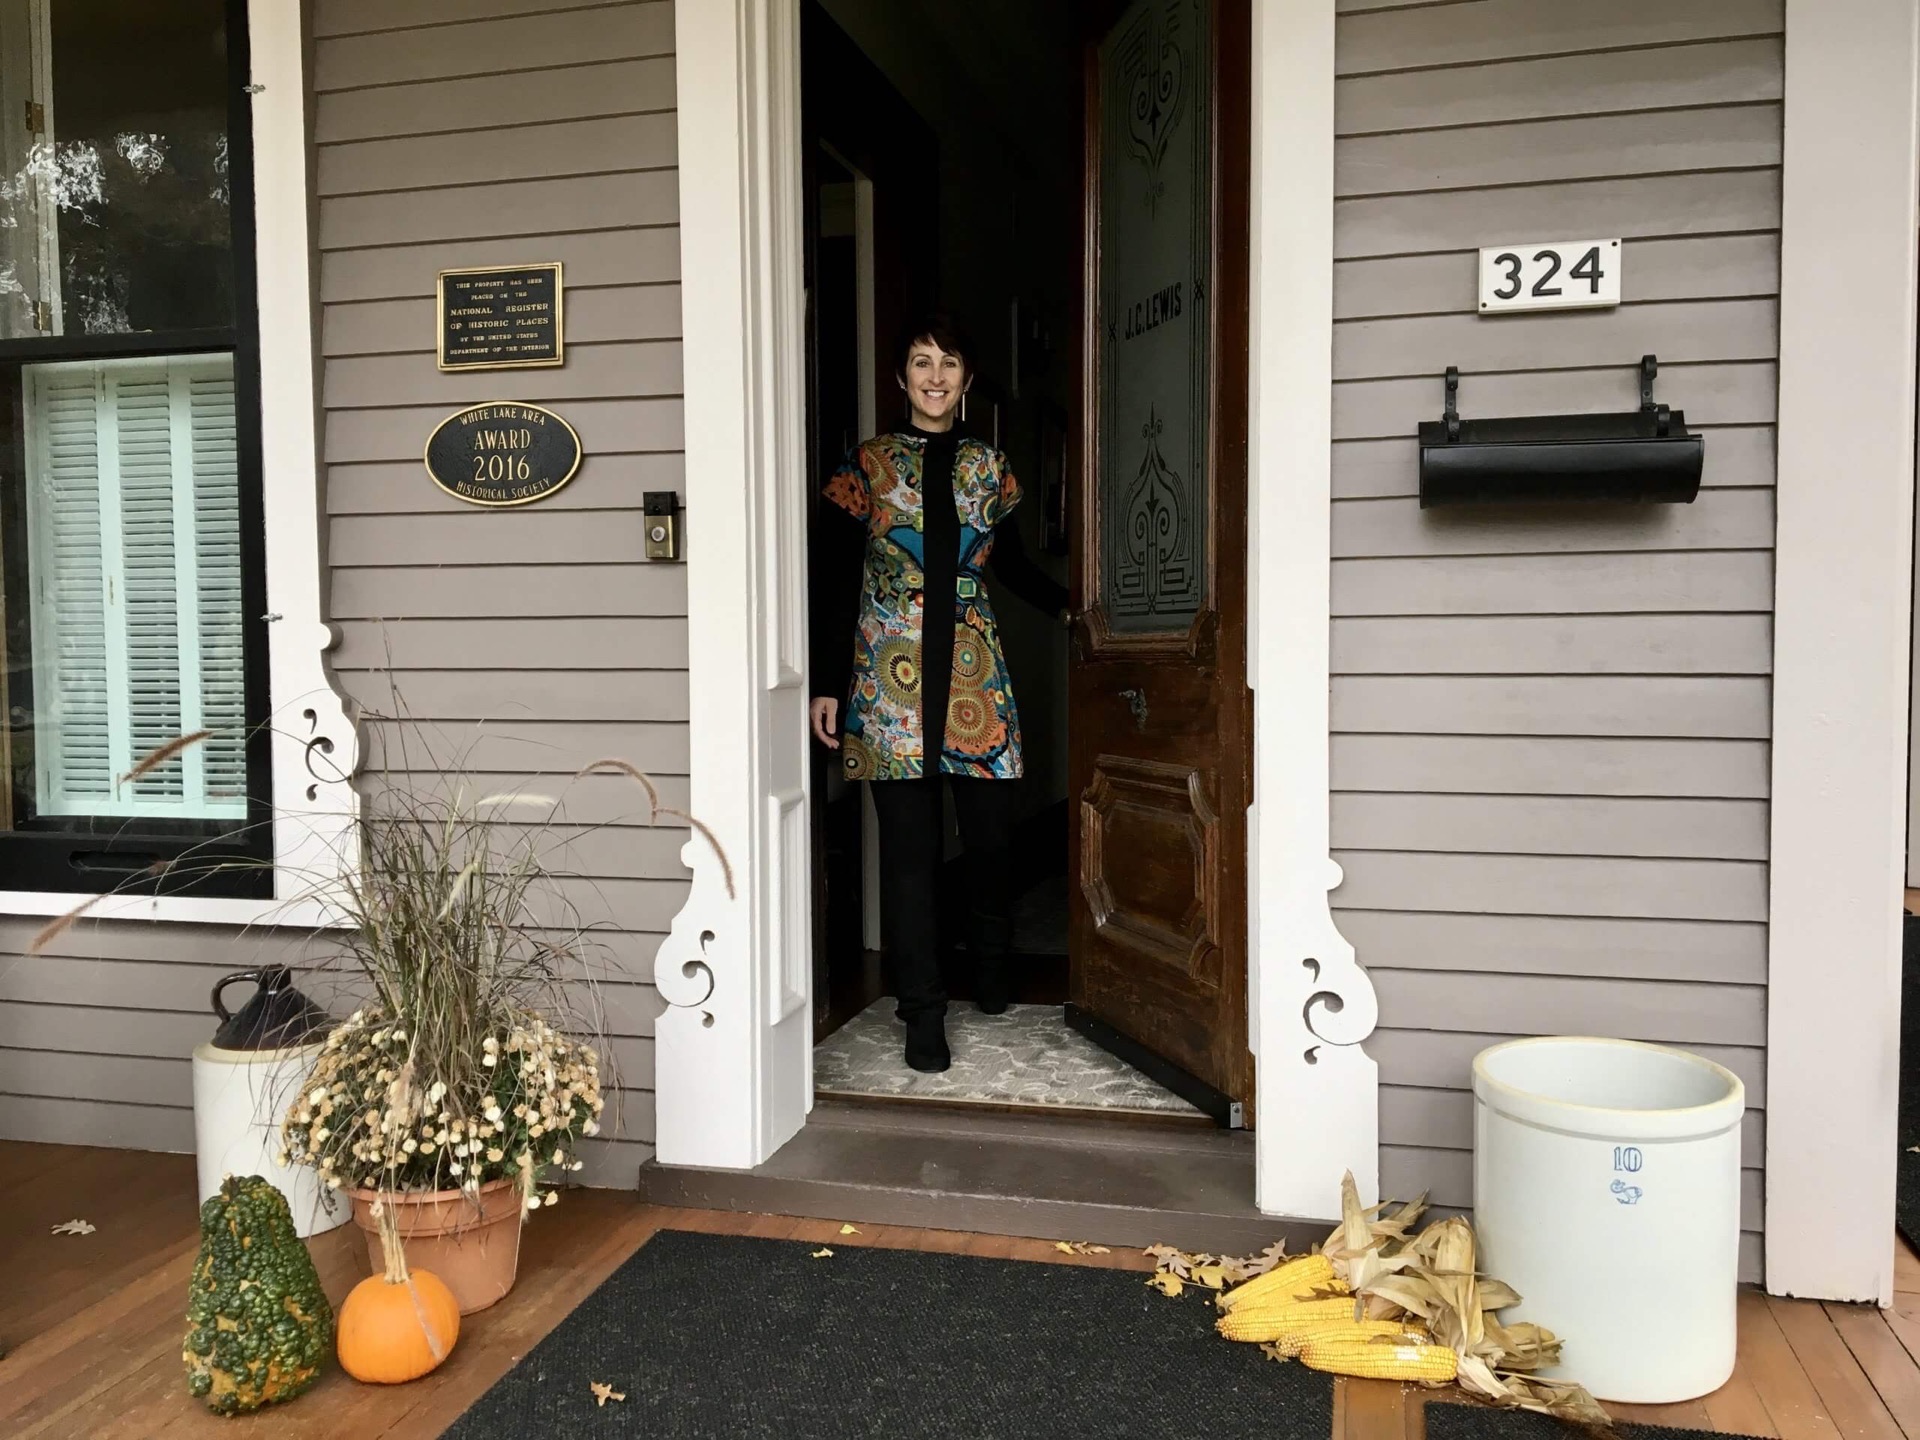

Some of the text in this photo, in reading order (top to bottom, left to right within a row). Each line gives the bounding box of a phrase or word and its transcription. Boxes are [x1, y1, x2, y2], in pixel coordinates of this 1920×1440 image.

[1493, 246, 1604, 299] 324
[450, 303, 549, 317] NATIONAL REGISTER
[450, 317, 549, 330] OF HISTORIC PLACES
[460, 407, 545, 426] WHITE LAKE AREA
[474, 428, 531, 450] AWARD
[473, 454, 530, 481] 2016
[456, 477, 551, 499] HISTORICAL SOCIETY
[1613, 1146, 1643, 1172] 10
